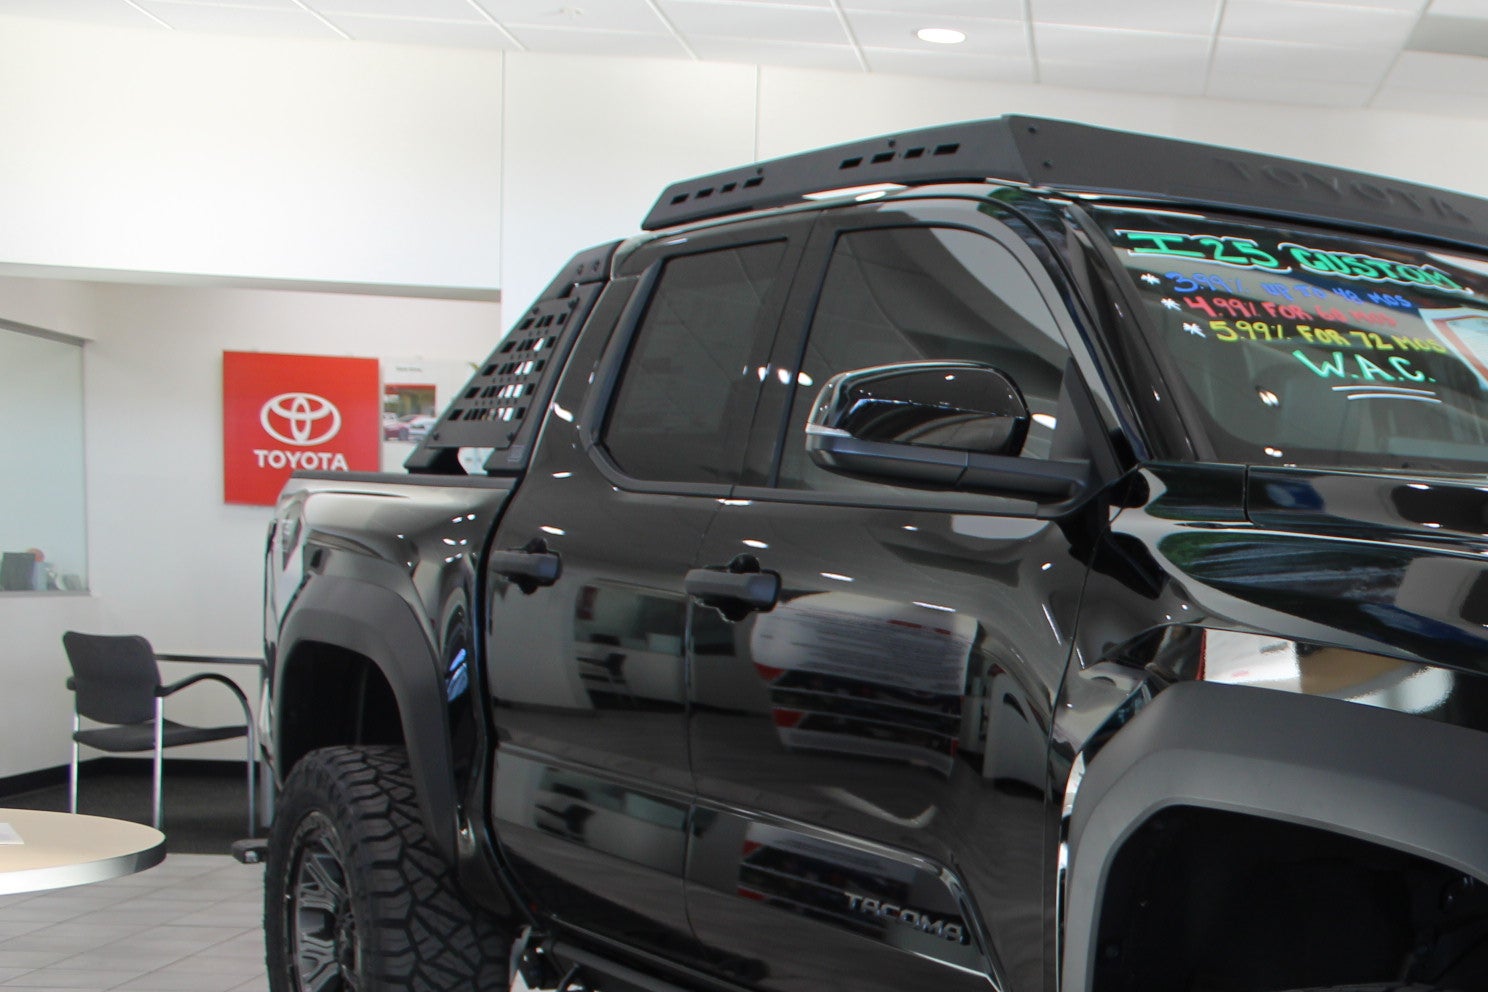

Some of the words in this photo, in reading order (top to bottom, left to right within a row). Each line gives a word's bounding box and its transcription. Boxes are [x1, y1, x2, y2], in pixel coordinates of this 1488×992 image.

[1289, 247, 1464, 290] CUSTOM
[1261, 301, 1315, 321] FOR
[1296, 325, 1352, 346] FOR
[1349, 331, 1395, 350] 72
[1391, 334, 1448, 355] MOS
[253, 449, 350, 471] TOYOTA
[843, 891, 965, 944] TACOMA
